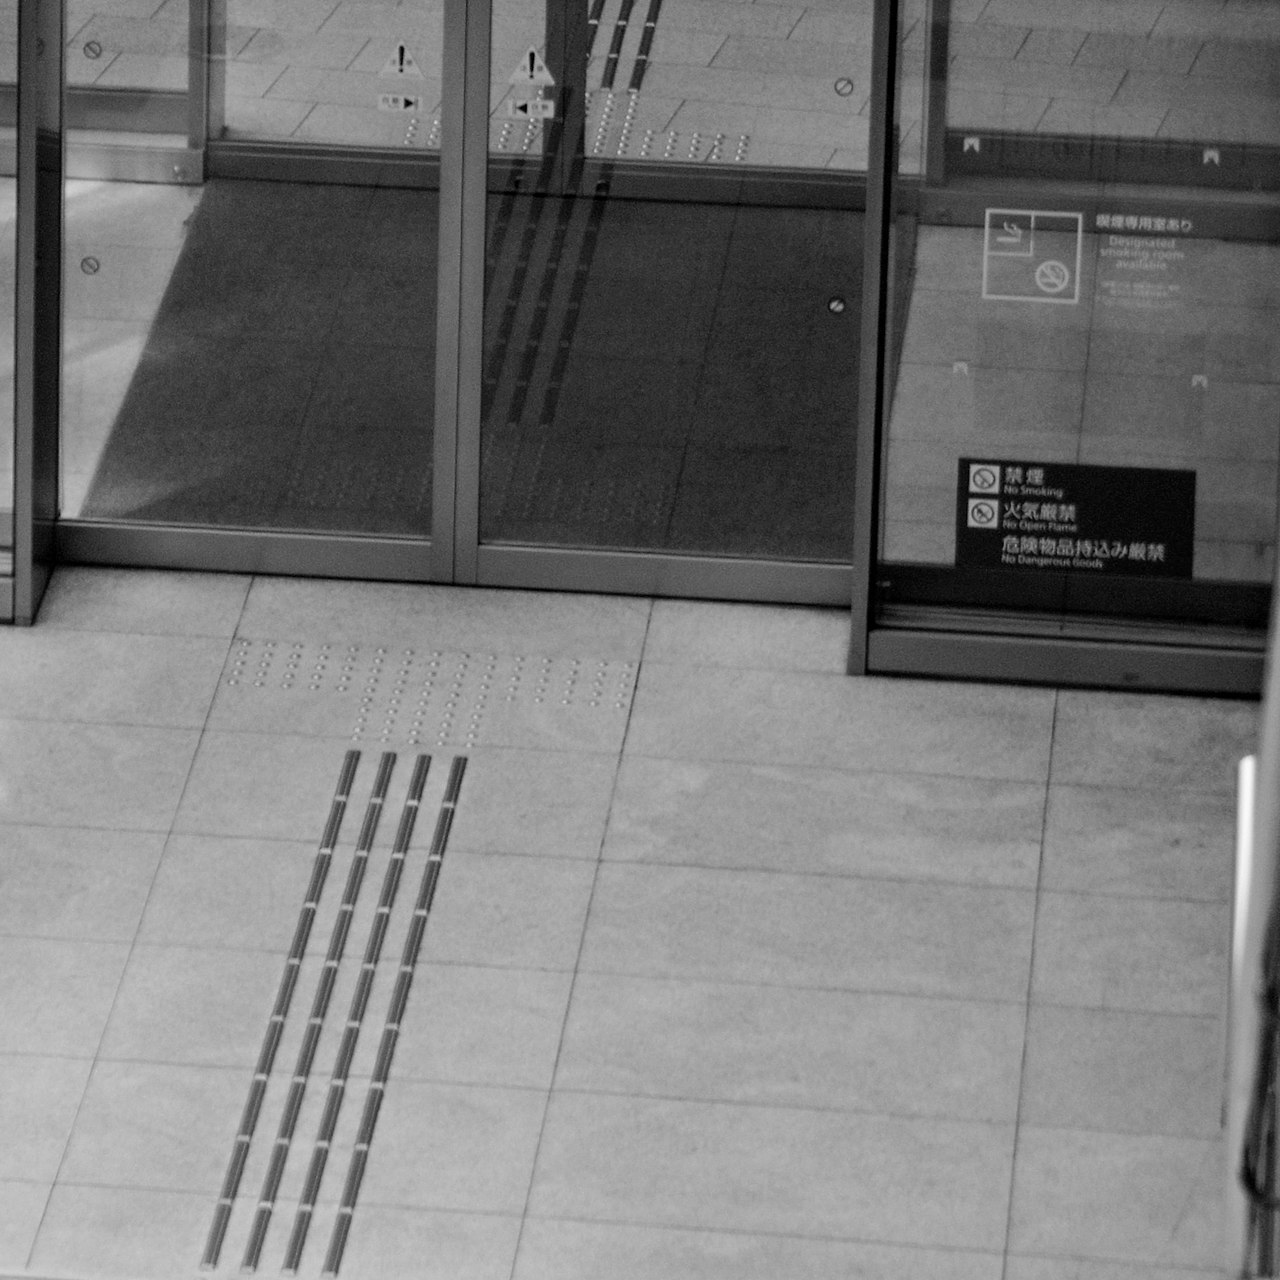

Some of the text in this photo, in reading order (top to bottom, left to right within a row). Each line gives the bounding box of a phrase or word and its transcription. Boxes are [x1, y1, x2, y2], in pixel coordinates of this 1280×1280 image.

[1109, 235, 1175, 250] Designated
[1100, 248, 1184, 262] smoking room
[1116, 260, 1167, 271] available
[1005, 466, 1044, 486] 禁煙
[1004, 485, 1064, 499] No Smoking
[1003, 501, 1076, 521] 火気厳禁
[1002, 520, 1078, 533] No Open Flame
[1002, 535, 1166, 561] 危険物品持込み厳禁
[1001, 554, 1016, 565] No
[1018, 554, 1071, 568] Dangerous
